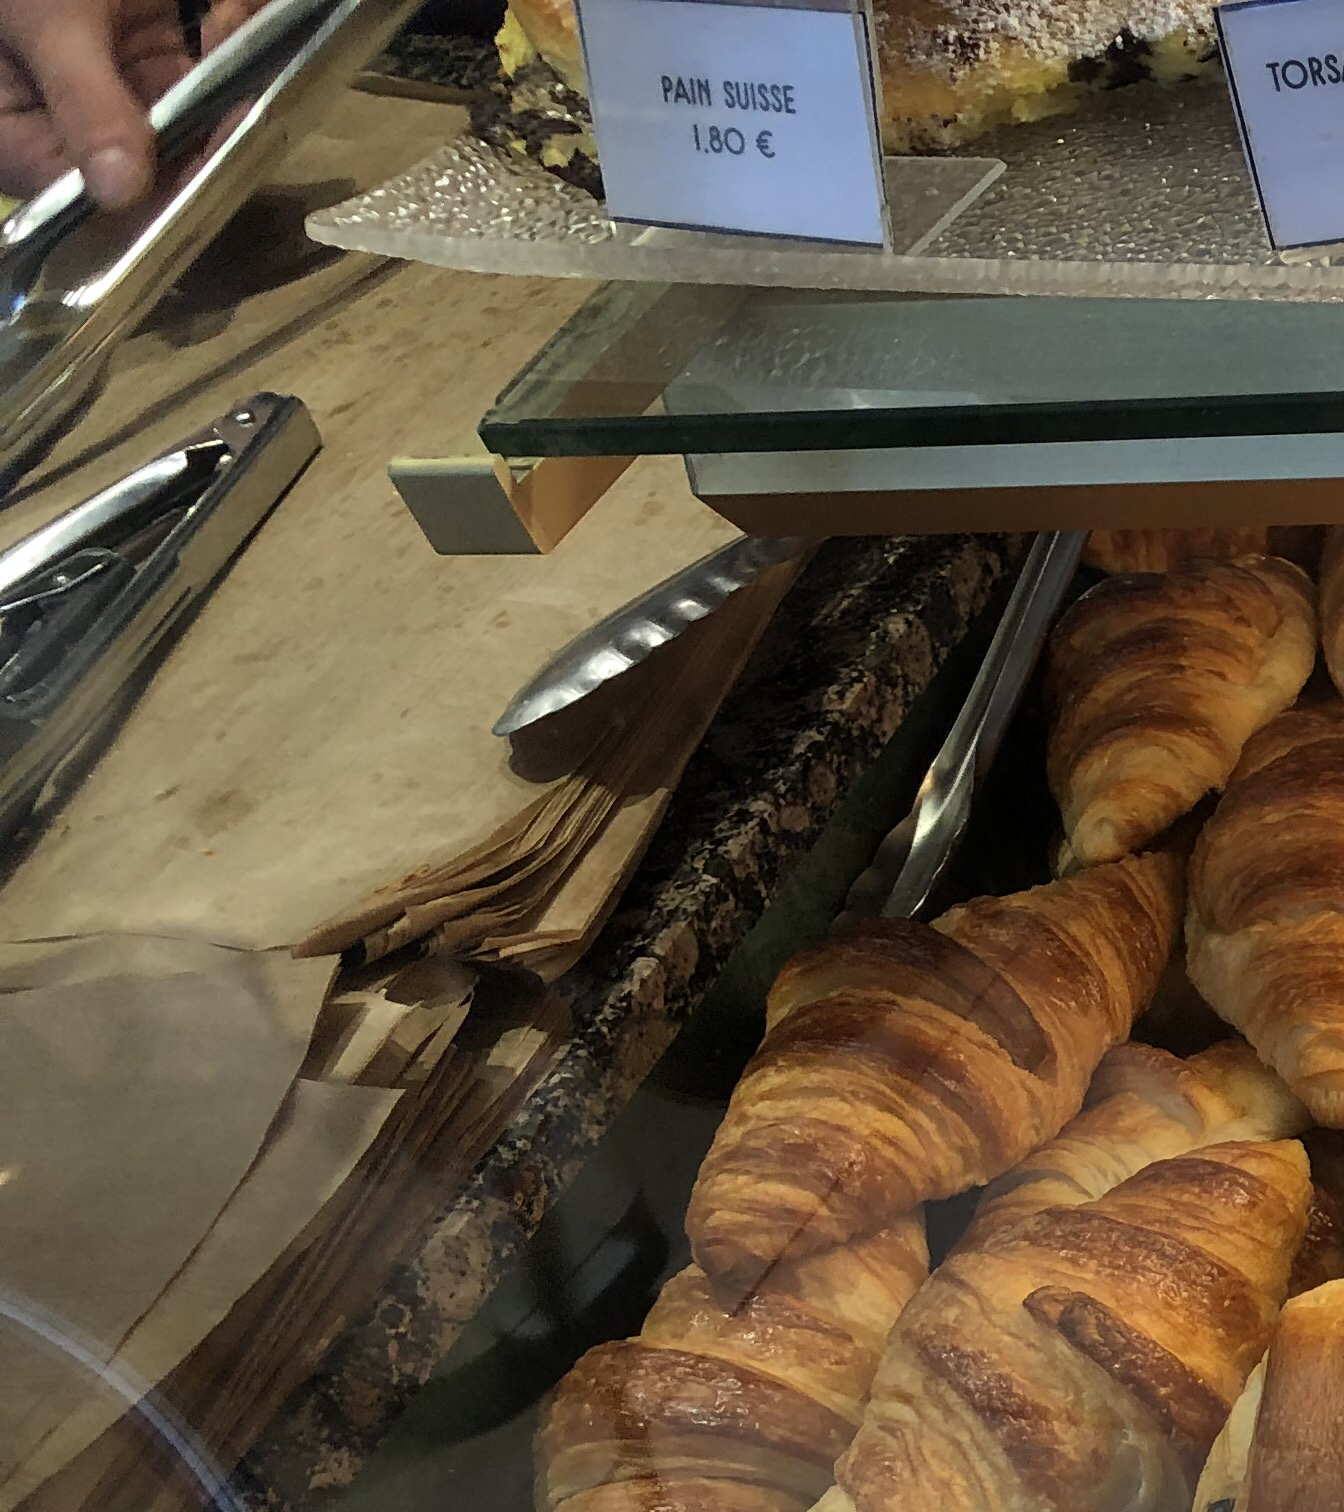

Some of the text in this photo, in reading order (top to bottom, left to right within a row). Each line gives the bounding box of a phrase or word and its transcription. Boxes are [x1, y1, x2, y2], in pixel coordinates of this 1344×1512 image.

[661, 74, 796, 114] PAIN SUISSE
[692, 124, 775, 158] 1.80 €
